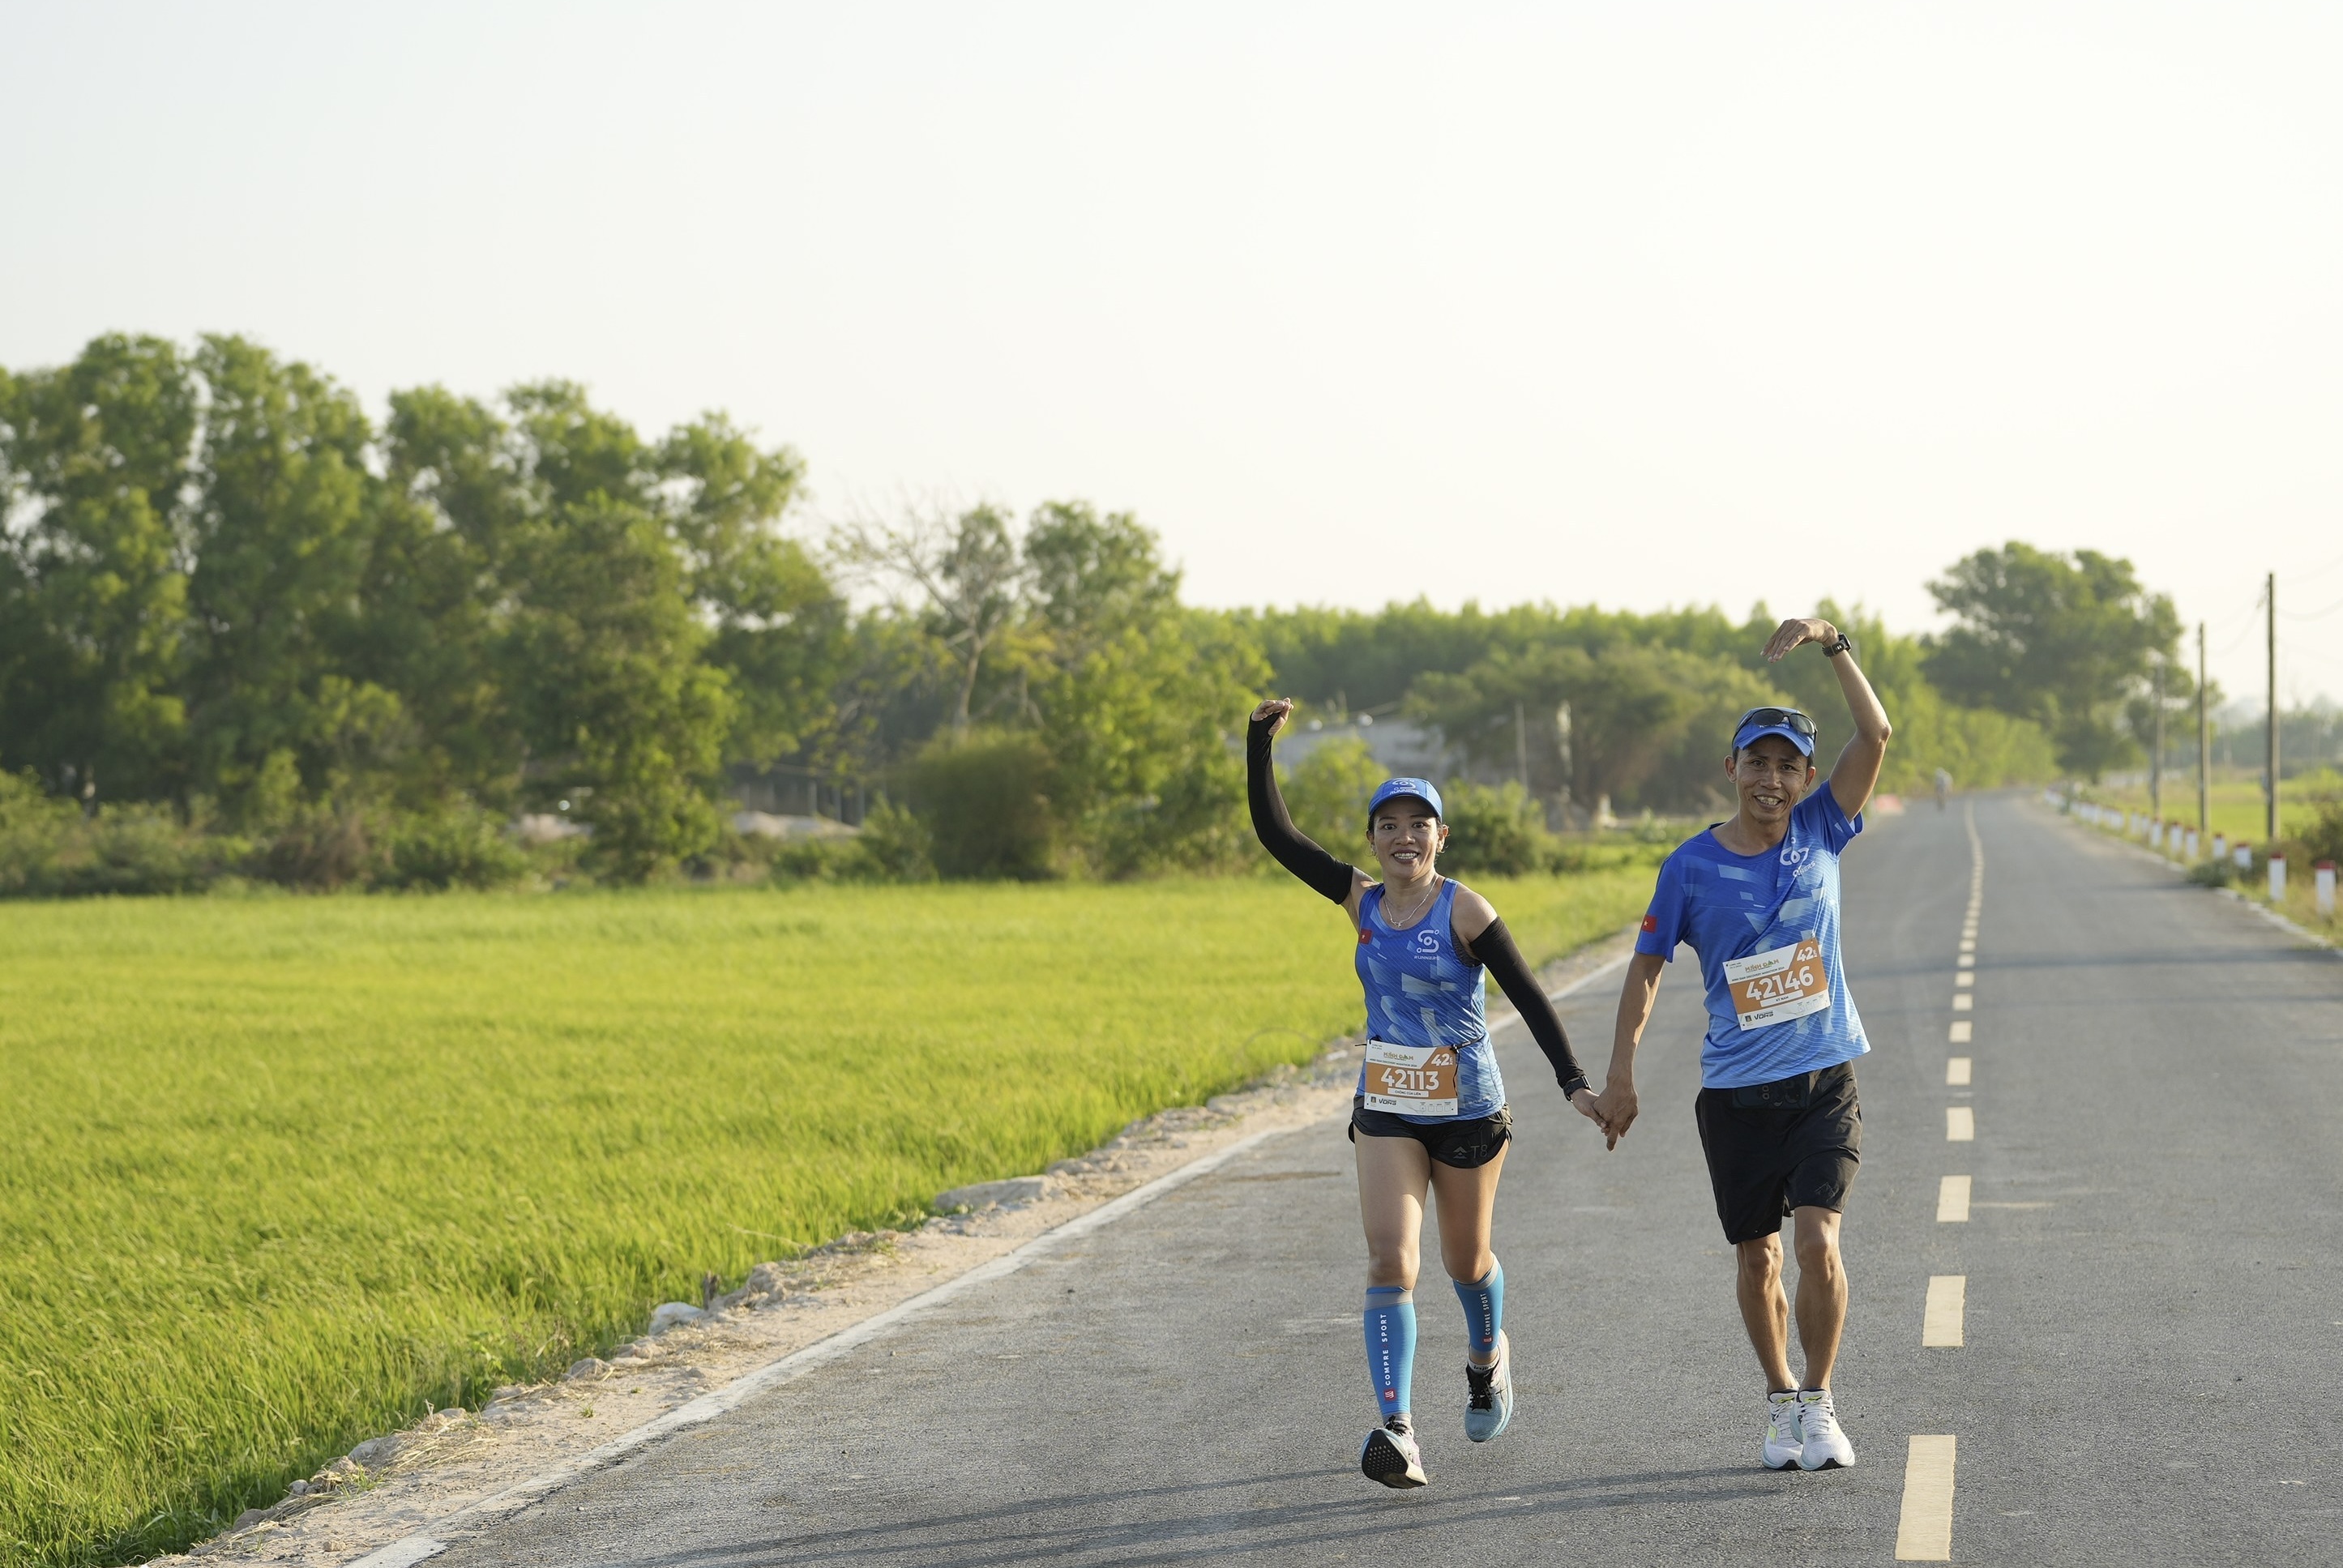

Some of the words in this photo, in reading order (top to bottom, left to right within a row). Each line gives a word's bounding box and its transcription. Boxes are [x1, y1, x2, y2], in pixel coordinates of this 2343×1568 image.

[1746, 965, 1815, 1001] 42146
[1380, 1067, 1439, 1091] 42113
[1470, 1144, 1488, 1159] T8
